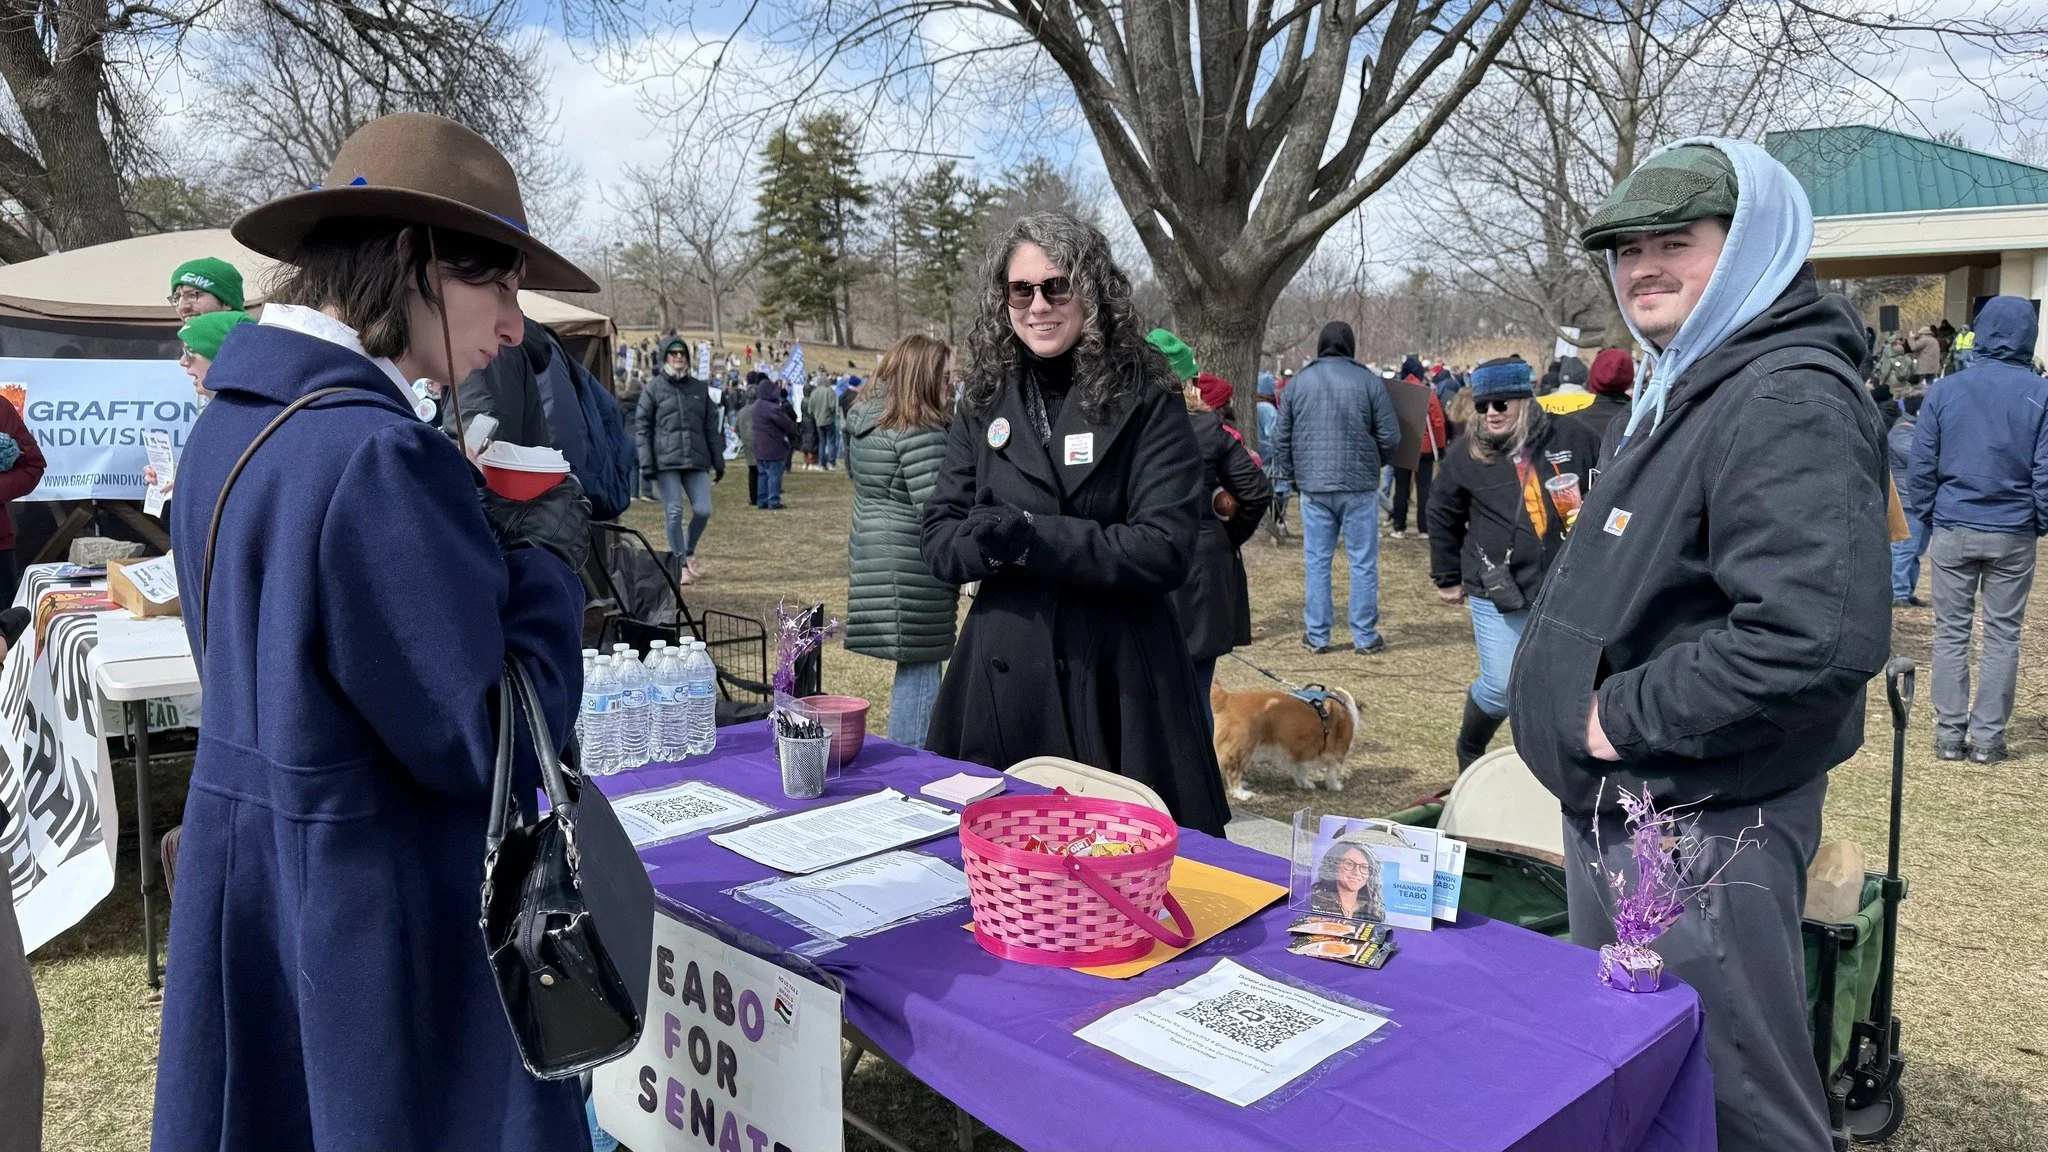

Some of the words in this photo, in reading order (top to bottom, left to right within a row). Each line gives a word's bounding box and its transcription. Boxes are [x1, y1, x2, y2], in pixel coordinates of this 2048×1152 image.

[27, 400, 198, 423] GRAFTON
[31, 427, 185, 448] INDIVISIL
[126, 700, 180, 728] BEAD
[1392, 883, 1428, 893] SHANNON
[1433, 874, 1456, 884] NNON
[1399, 890, 1427, 900] TEABO
[656, 945, 765, 1042] EABO
[664, 1011, 738, 1098] FOR
[638, 1065, 792, 1152] SENAT
